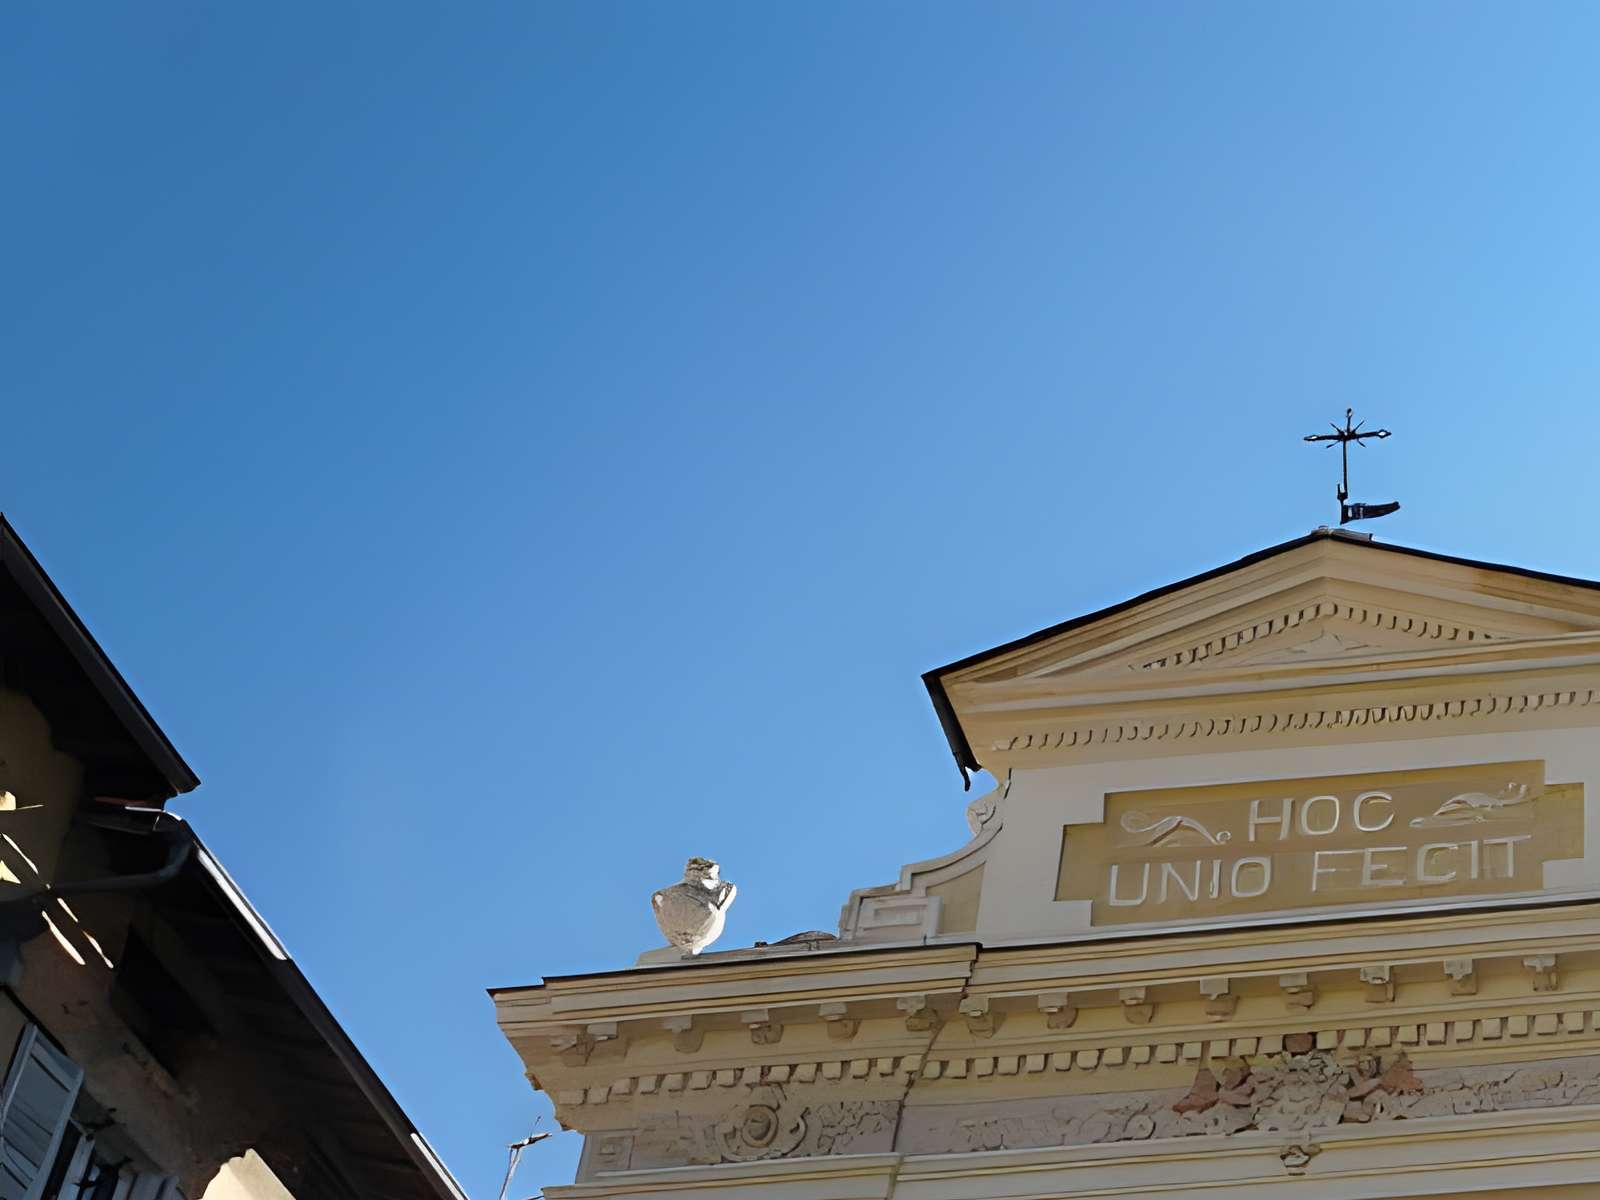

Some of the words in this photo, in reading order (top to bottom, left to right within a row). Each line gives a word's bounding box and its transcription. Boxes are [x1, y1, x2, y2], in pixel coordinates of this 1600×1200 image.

[1247, 790, 1395, 842] HOC
[1107, 855, 1273, 907] UNIO
[1310, 834, 1532, 892] FECIT
